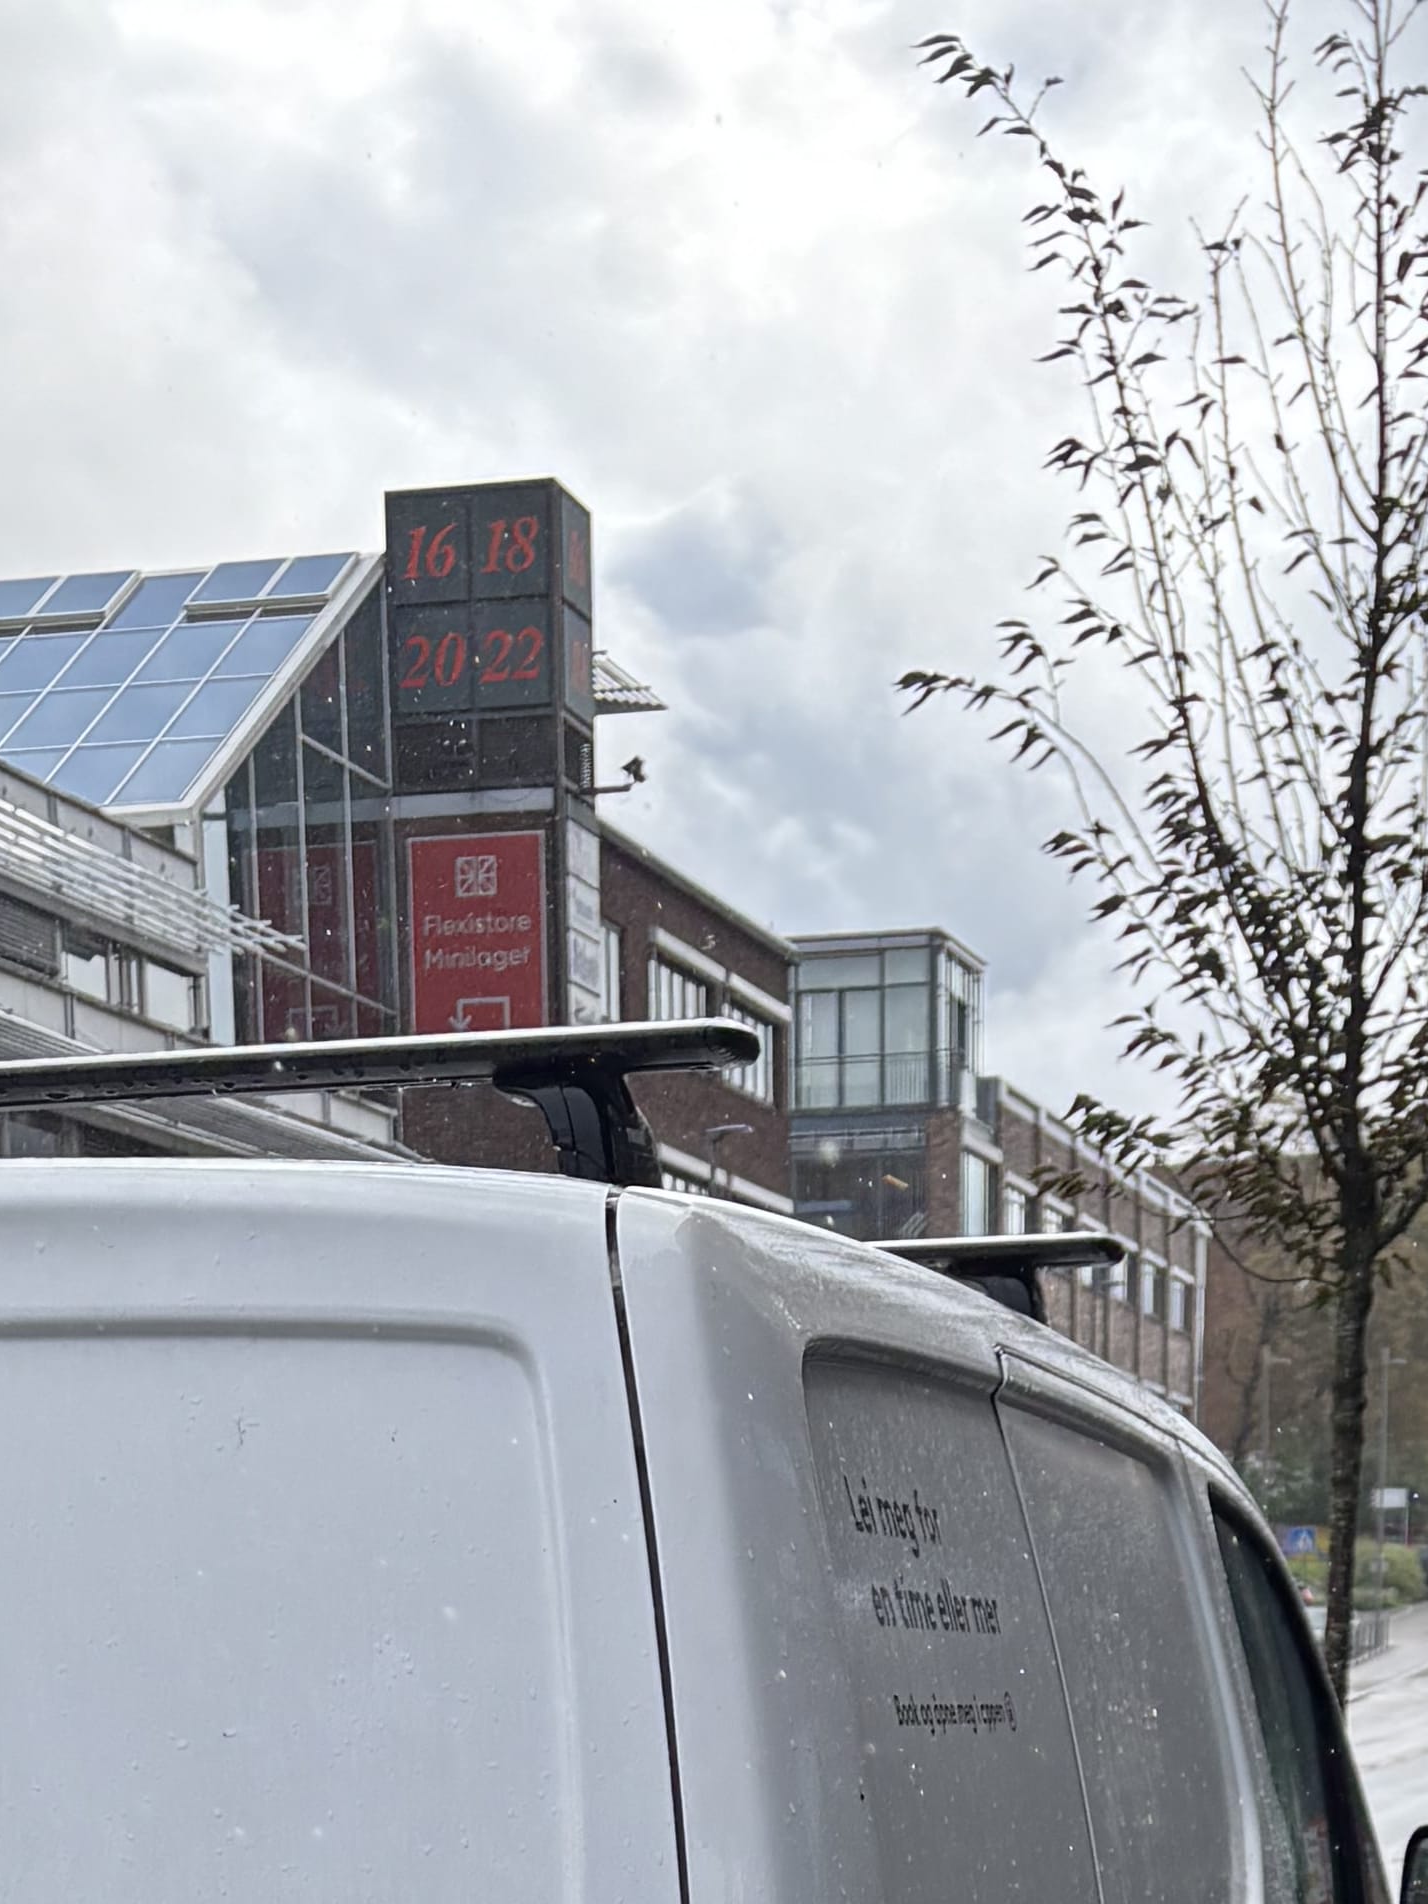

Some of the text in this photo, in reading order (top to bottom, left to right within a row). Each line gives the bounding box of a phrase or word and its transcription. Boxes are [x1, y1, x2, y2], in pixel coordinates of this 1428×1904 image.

[401, 522, 458, 580] 16
[480, 516, 539, 575] 18
[399, 632, 466, 689] 20
[479, 625, 544, 684] 22
[423, 912, 532, 936] Flexistore
[424, 946, 531, 972] Minilager
[844, 1475, 942, 1558] Lei meg for
[872, 1575, 1001, 1634] en time eller mer
[893, 1694, 921, 1726] Book
